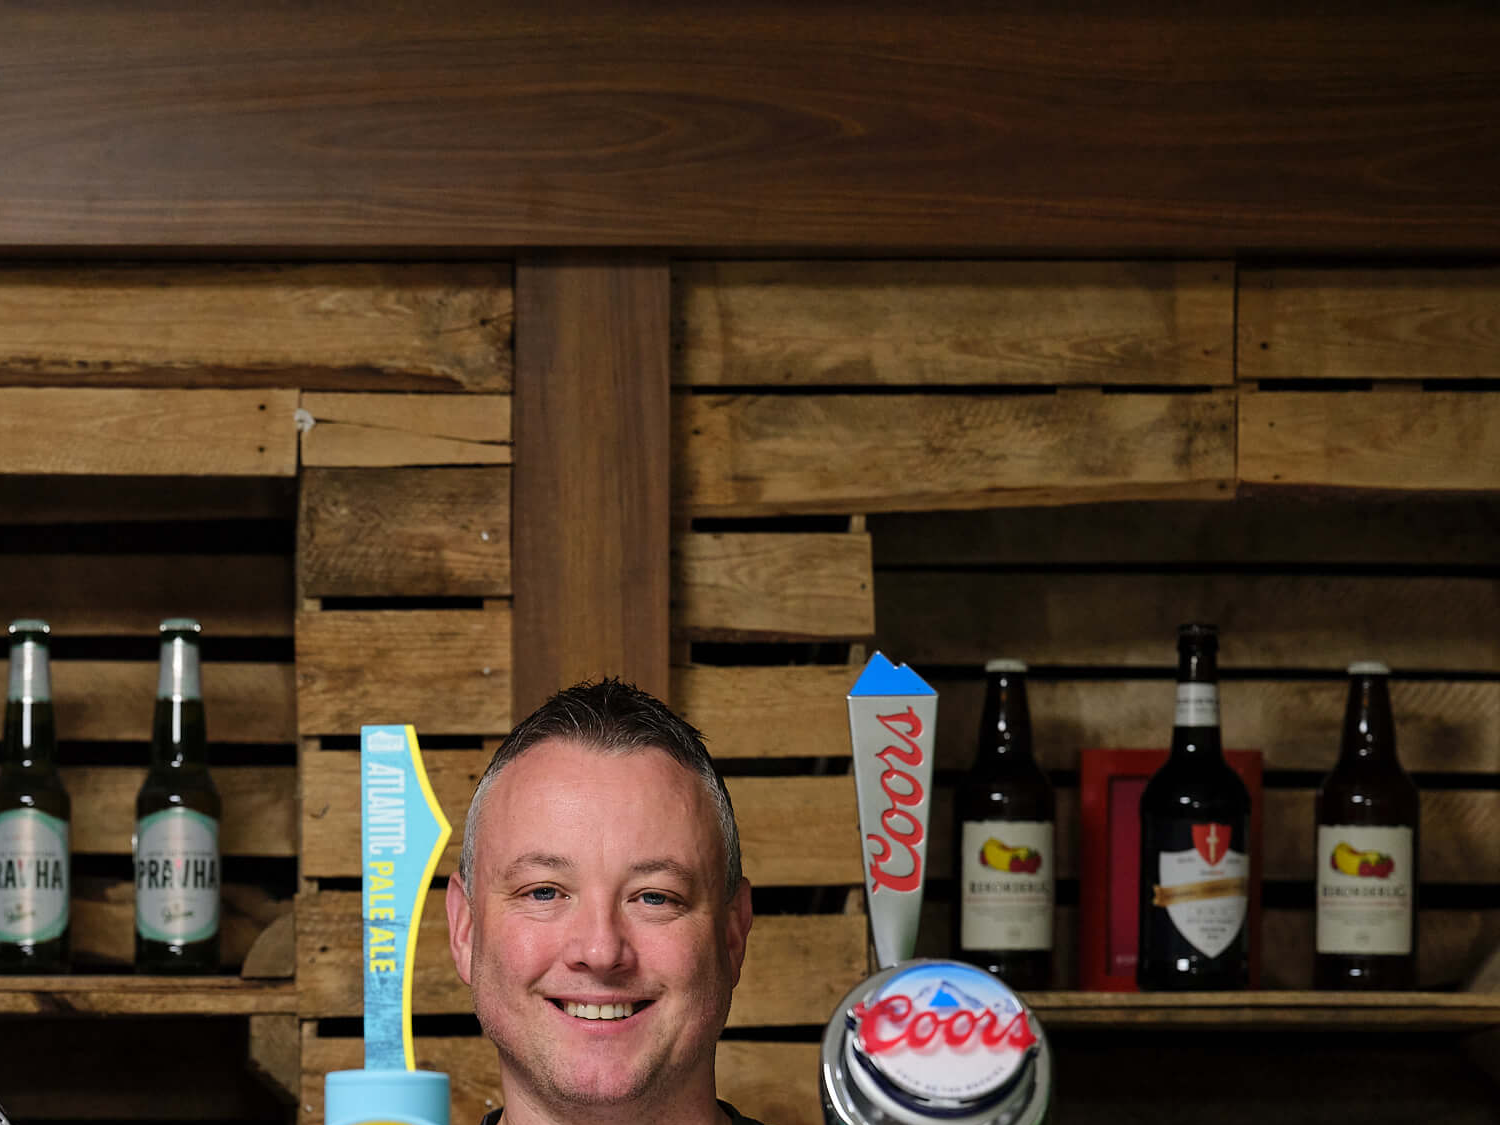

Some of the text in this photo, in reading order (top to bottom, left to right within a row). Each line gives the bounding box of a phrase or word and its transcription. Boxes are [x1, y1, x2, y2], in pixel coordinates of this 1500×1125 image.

[367, 761, 406, 855] ATLANTIC
[867, 706, 924, 894] Coors
[369, 861, 395, 974] PALE ALE
[854, 994, 1038, 1055] Coors
